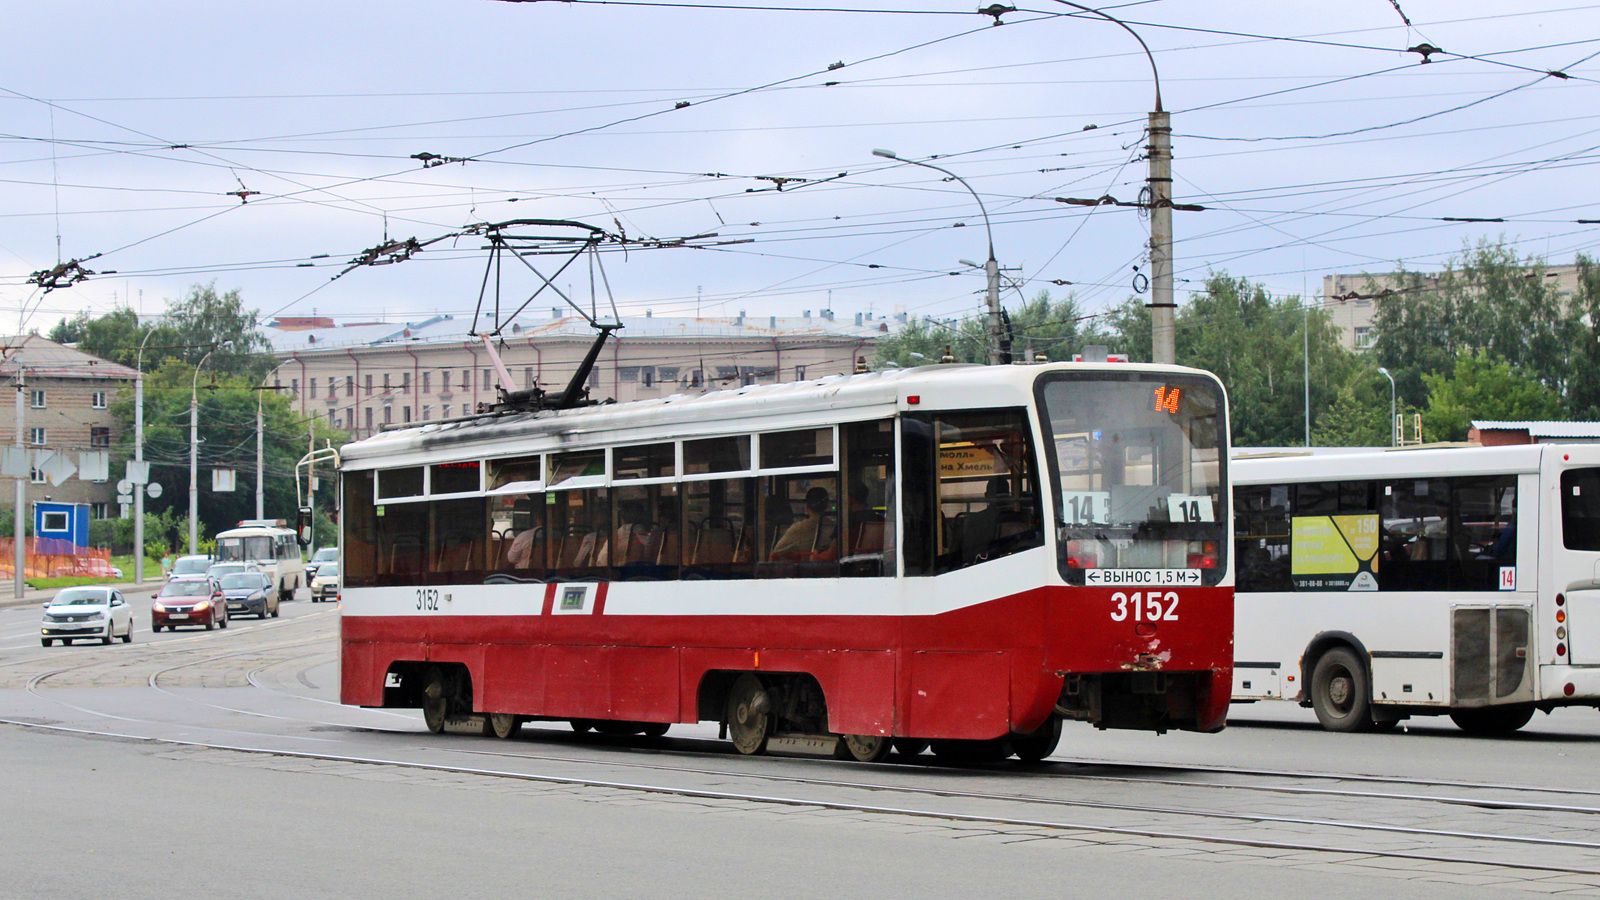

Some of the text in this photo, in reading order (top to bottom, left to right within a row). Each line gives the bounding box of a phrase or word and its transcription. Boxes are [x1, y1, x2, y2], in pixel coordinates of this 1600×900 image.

[1154, 386, 1180, 413] 14
[1068, 495, 1095, 525] 14
[1179, 500, 1202, 523] 14
[1356, 517, 1377, 534] 150
[1103, 571, 1186, 584] ВЫНОС 1,5 М
[1501, 570, 1513, 586] 14
[416, 589, 439, 611] 3152
[1110, 591, 1179, 622] 3152
